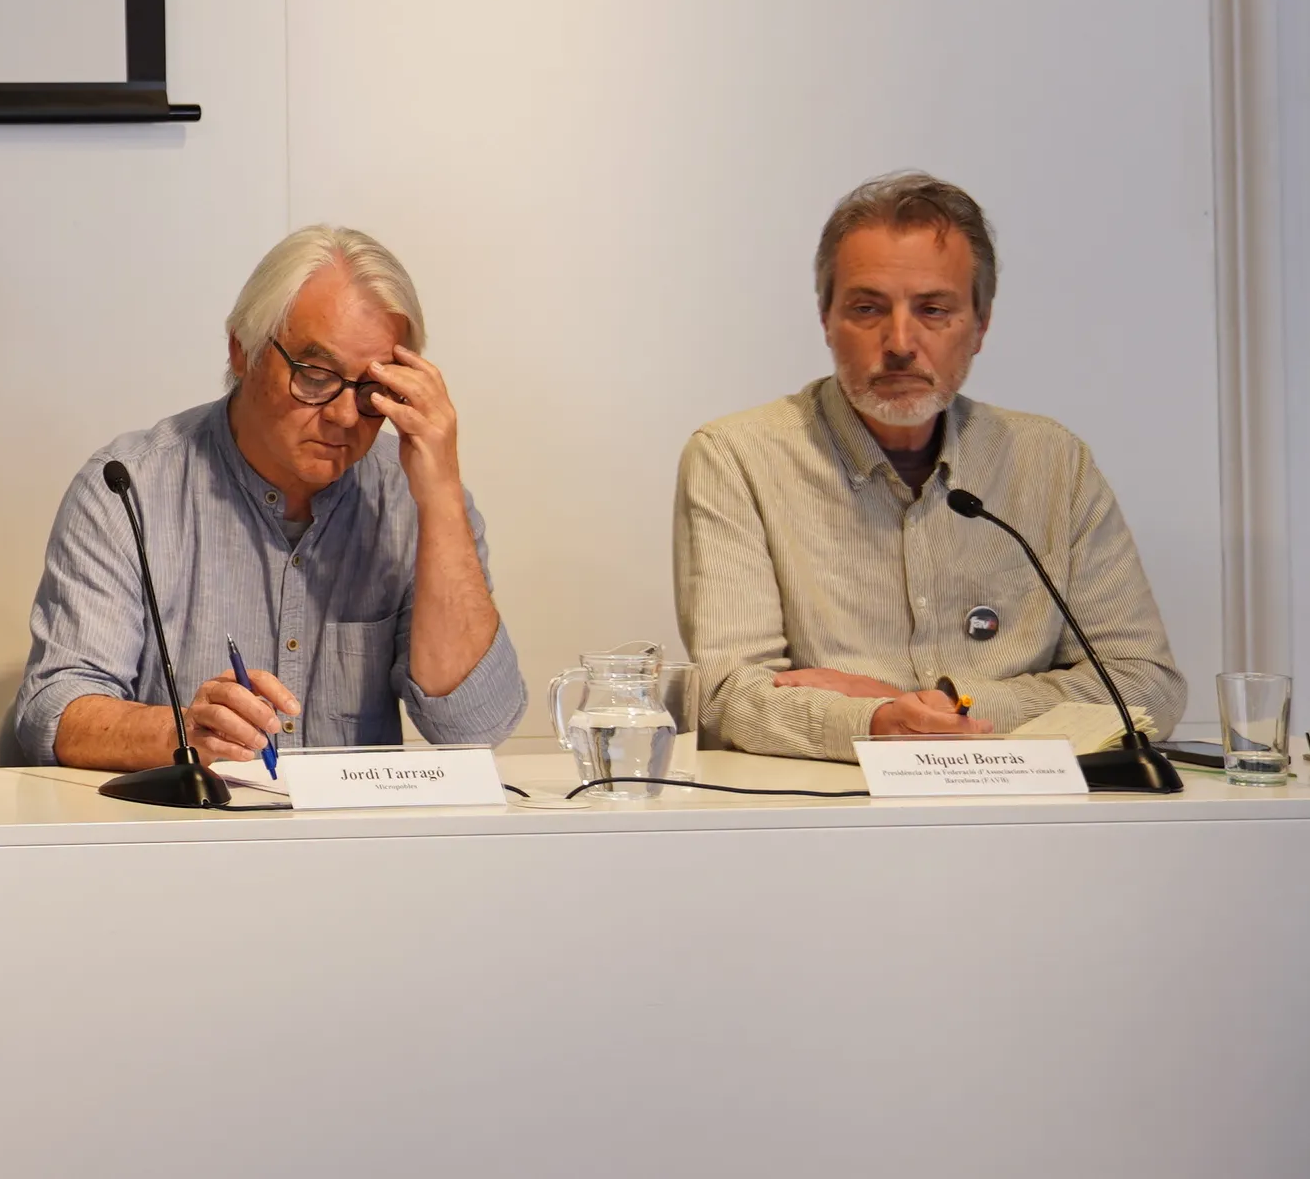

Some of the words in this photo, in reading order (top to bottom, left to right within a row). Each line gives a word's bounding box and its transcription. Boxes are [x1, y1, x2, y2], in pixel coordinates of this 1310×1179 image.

[914, 753, 970, 768] Miquel
[972, 752, 1026, 765] Borràs
[340, 767, 380, 781] Jordi
[382, 766, 446, 782] Tarragó
